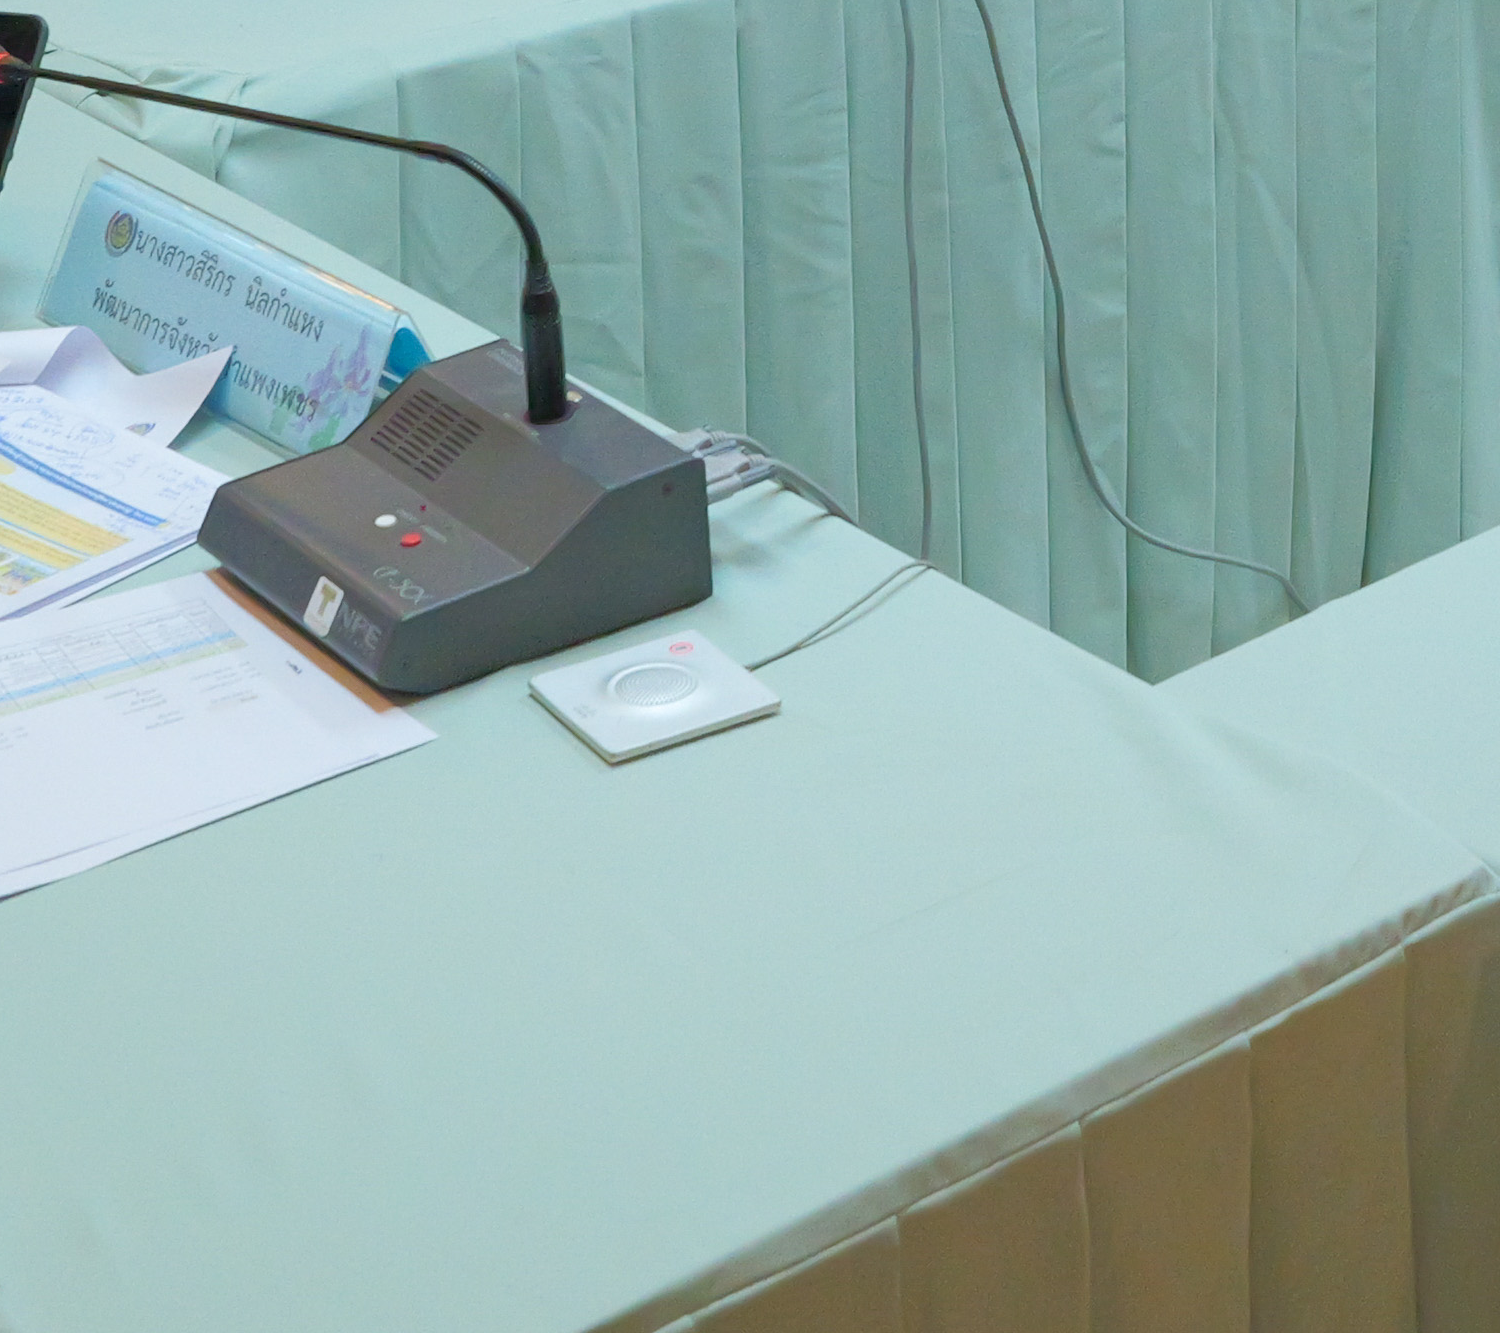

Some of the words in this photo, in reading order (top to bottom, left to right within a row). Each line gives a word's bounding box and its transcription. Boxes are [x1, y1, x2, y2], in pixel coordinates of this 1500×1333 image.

[134, 230, 236, 296] นางสาวสิริกร
[244, 275, 325, 343] นิลกำแหง
